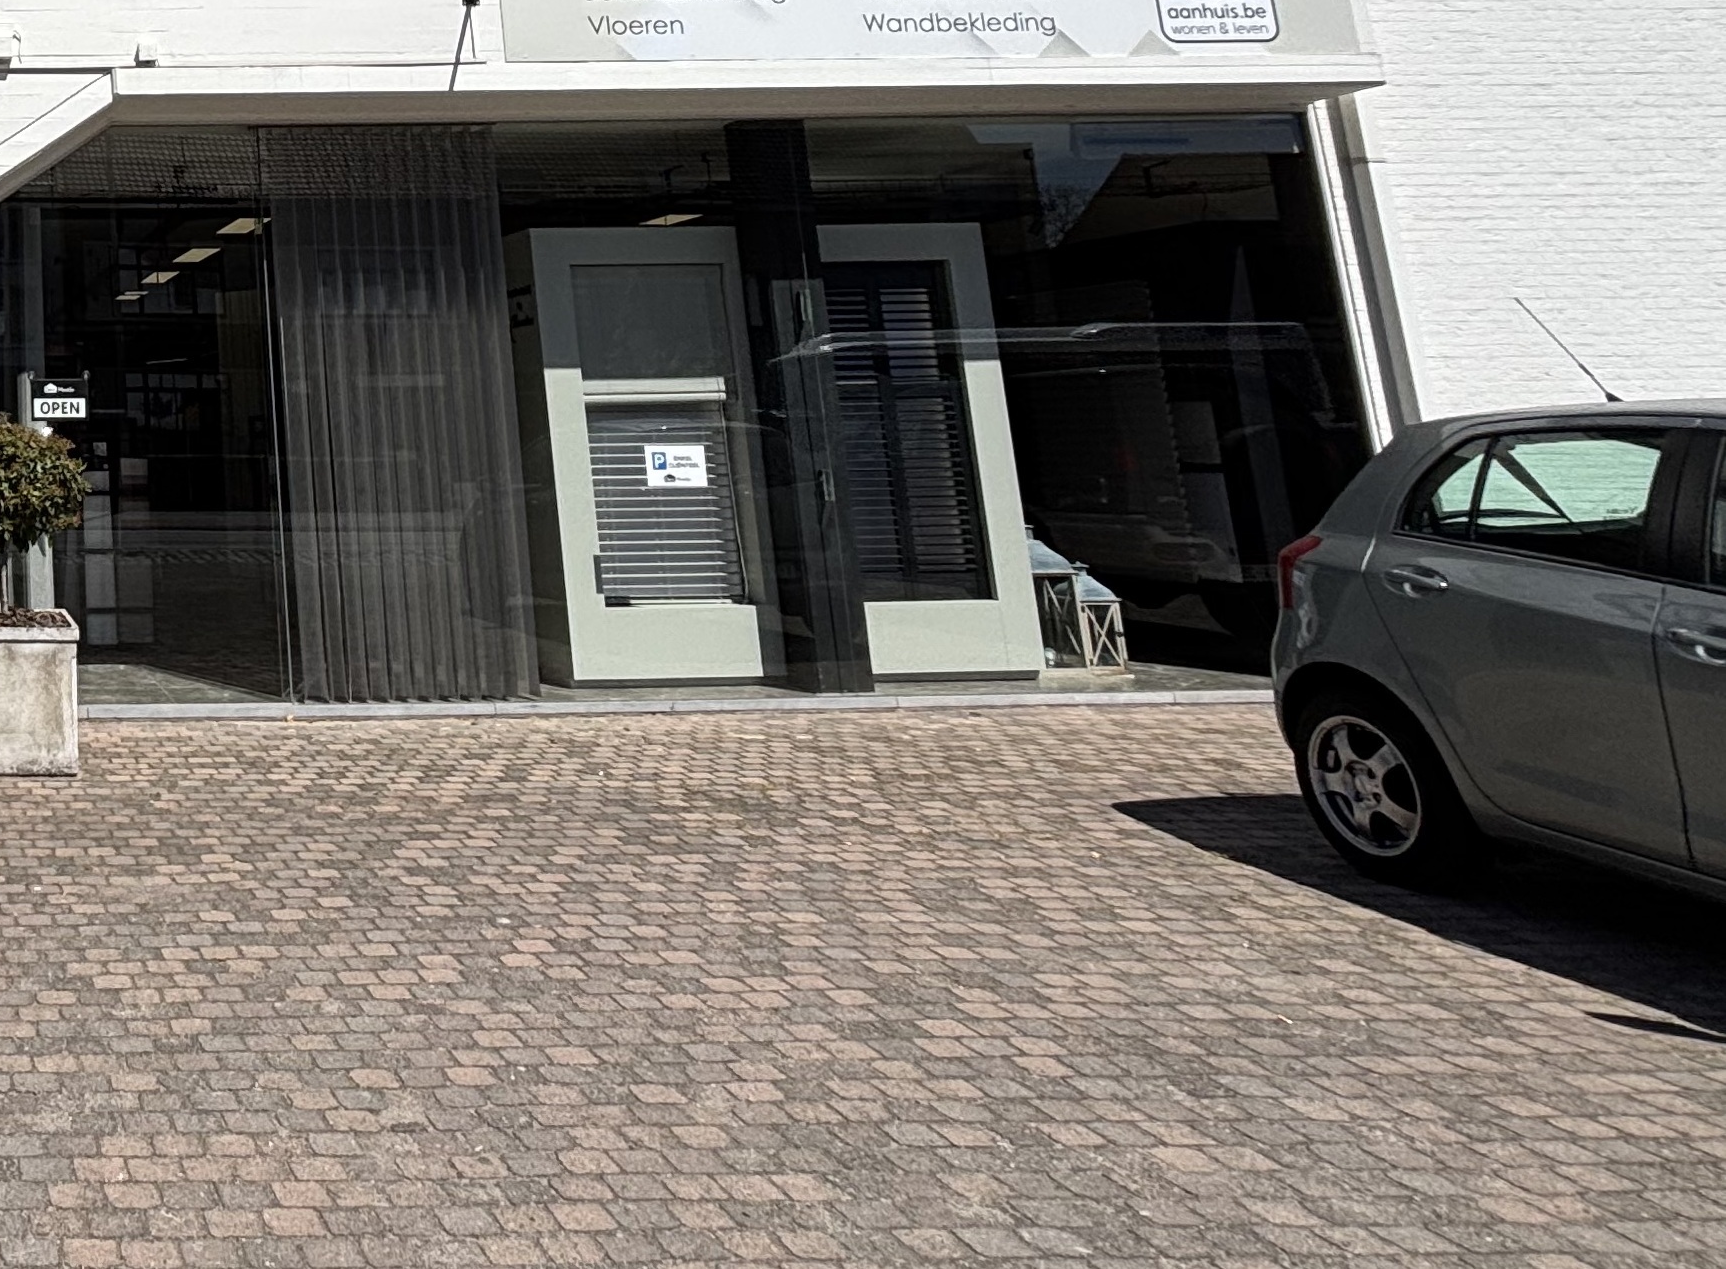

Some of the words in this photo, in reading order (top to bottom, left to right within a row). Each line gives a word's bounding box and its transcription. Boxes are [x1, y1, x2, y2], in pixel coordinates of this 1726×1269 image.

[1167, 3, 1267, 19] aanhuis.be
[587, 15, 685, 35] Vloeren
[862, 12, 1057, 36] Wandbekleding
[1170, 24, 1216, 35] wonen
[1219, 22, 1230, 35] &
[1233, 22, 1270, 35] leven
[40, 401, 80, 415] OPEN
